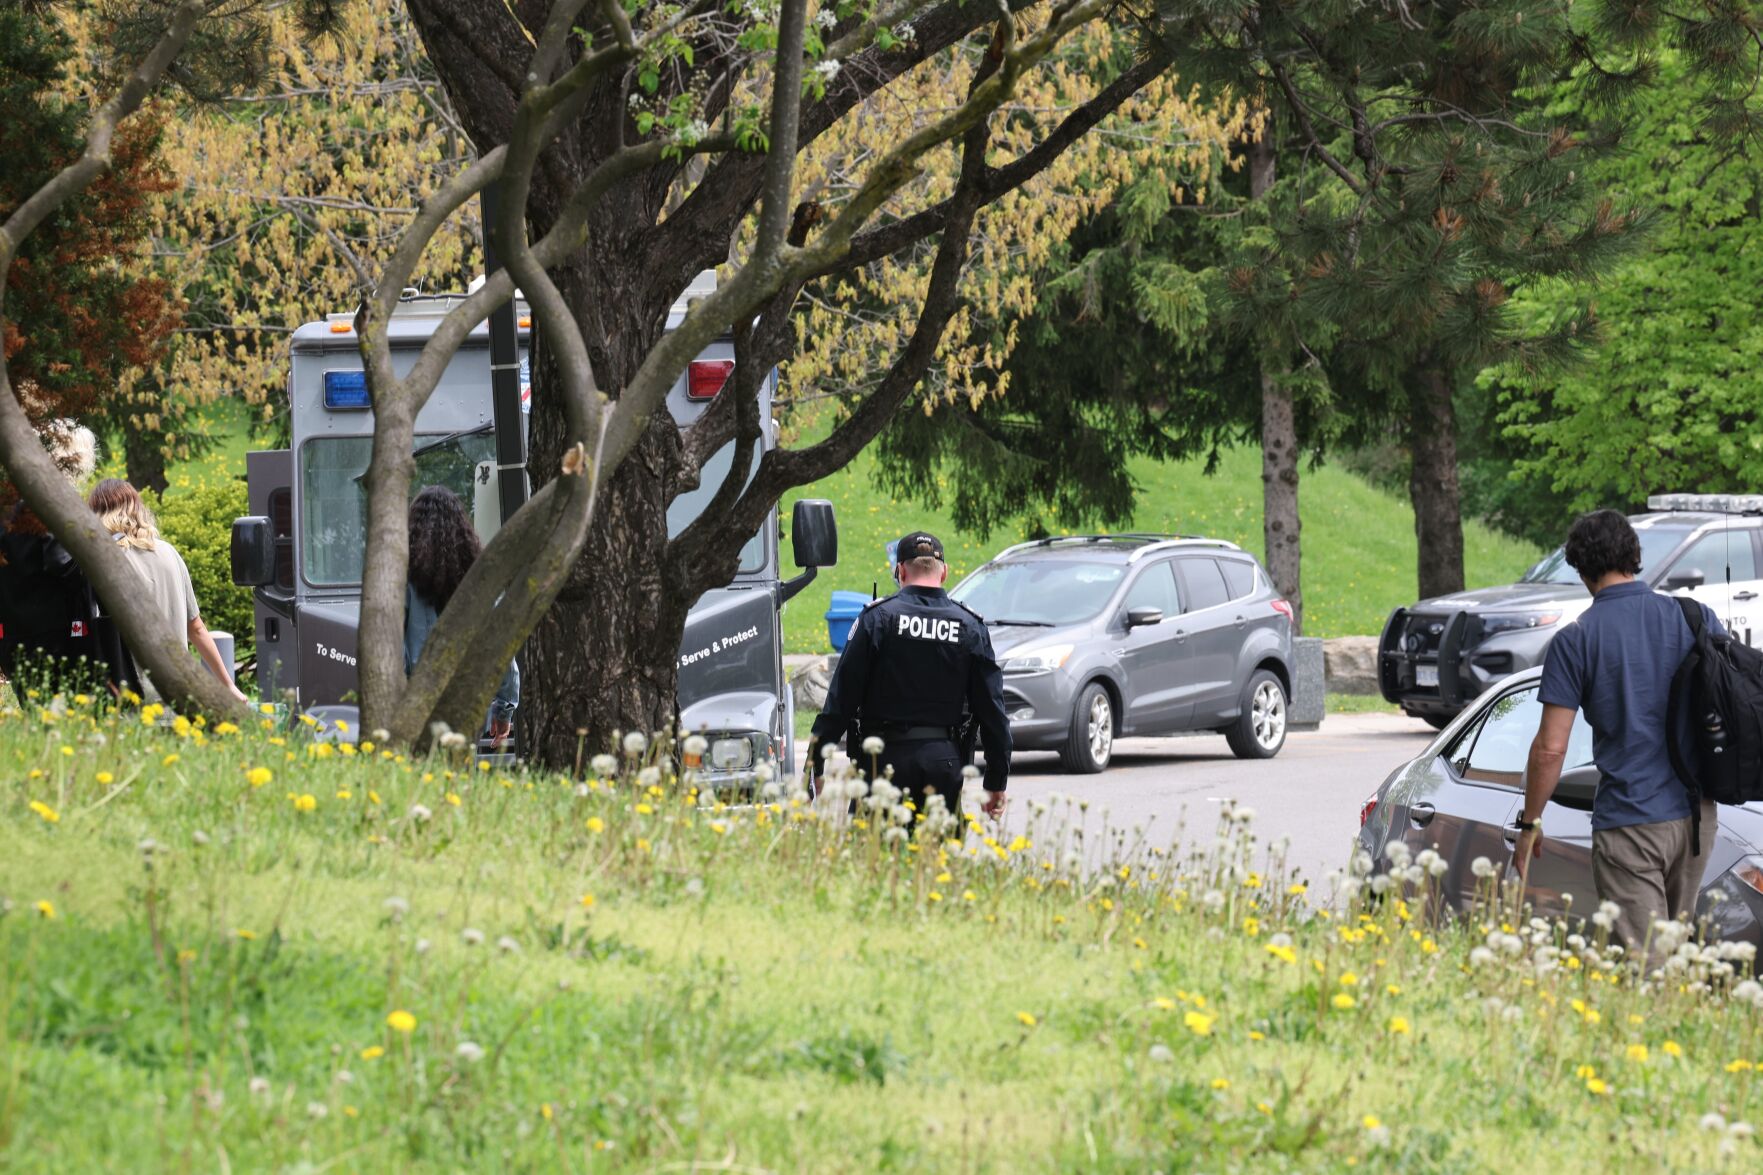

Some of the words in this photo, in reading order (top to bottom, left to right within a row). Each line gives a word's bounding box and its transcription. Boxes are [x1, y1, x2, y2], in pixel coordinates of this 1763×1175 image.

[898, 614, 960, 642] POLICE
[316, 642, 327, 656] To
[329, 648, 357, 666] Serve
[681, 648, 710, 666] Serve
[712, 641, 721, 653] &
[721, 625, 758, 649] Protect
